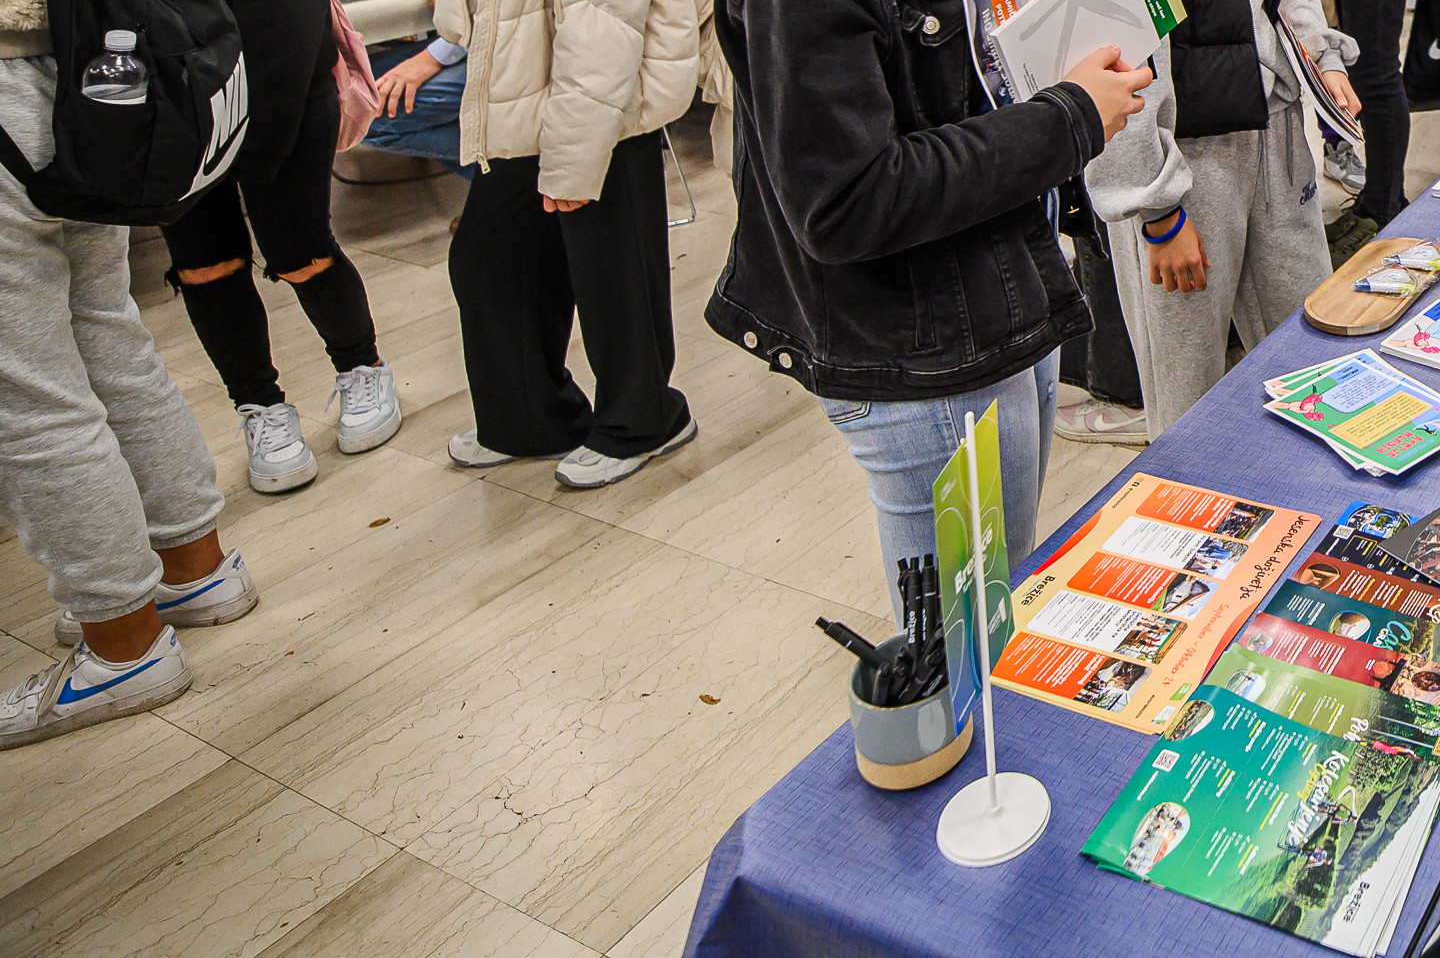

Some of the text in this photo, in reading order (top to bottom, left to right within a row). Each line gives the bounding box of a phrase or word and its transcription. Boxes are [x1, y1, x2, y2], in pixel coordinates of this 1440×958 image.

[1239, 515, 1311, 600] Jesenska doživetja
[1021, 575, 1056, 606] Brežice
[1198, 603, 1230, 640] September
[1170, 648, 1197, 674] Oktober
[1288, 750, 1350, 846] Kolesarjenje
[1296, 763, 1327, 801] Cycling
[1343, 880, 1371, 923] Brežice
